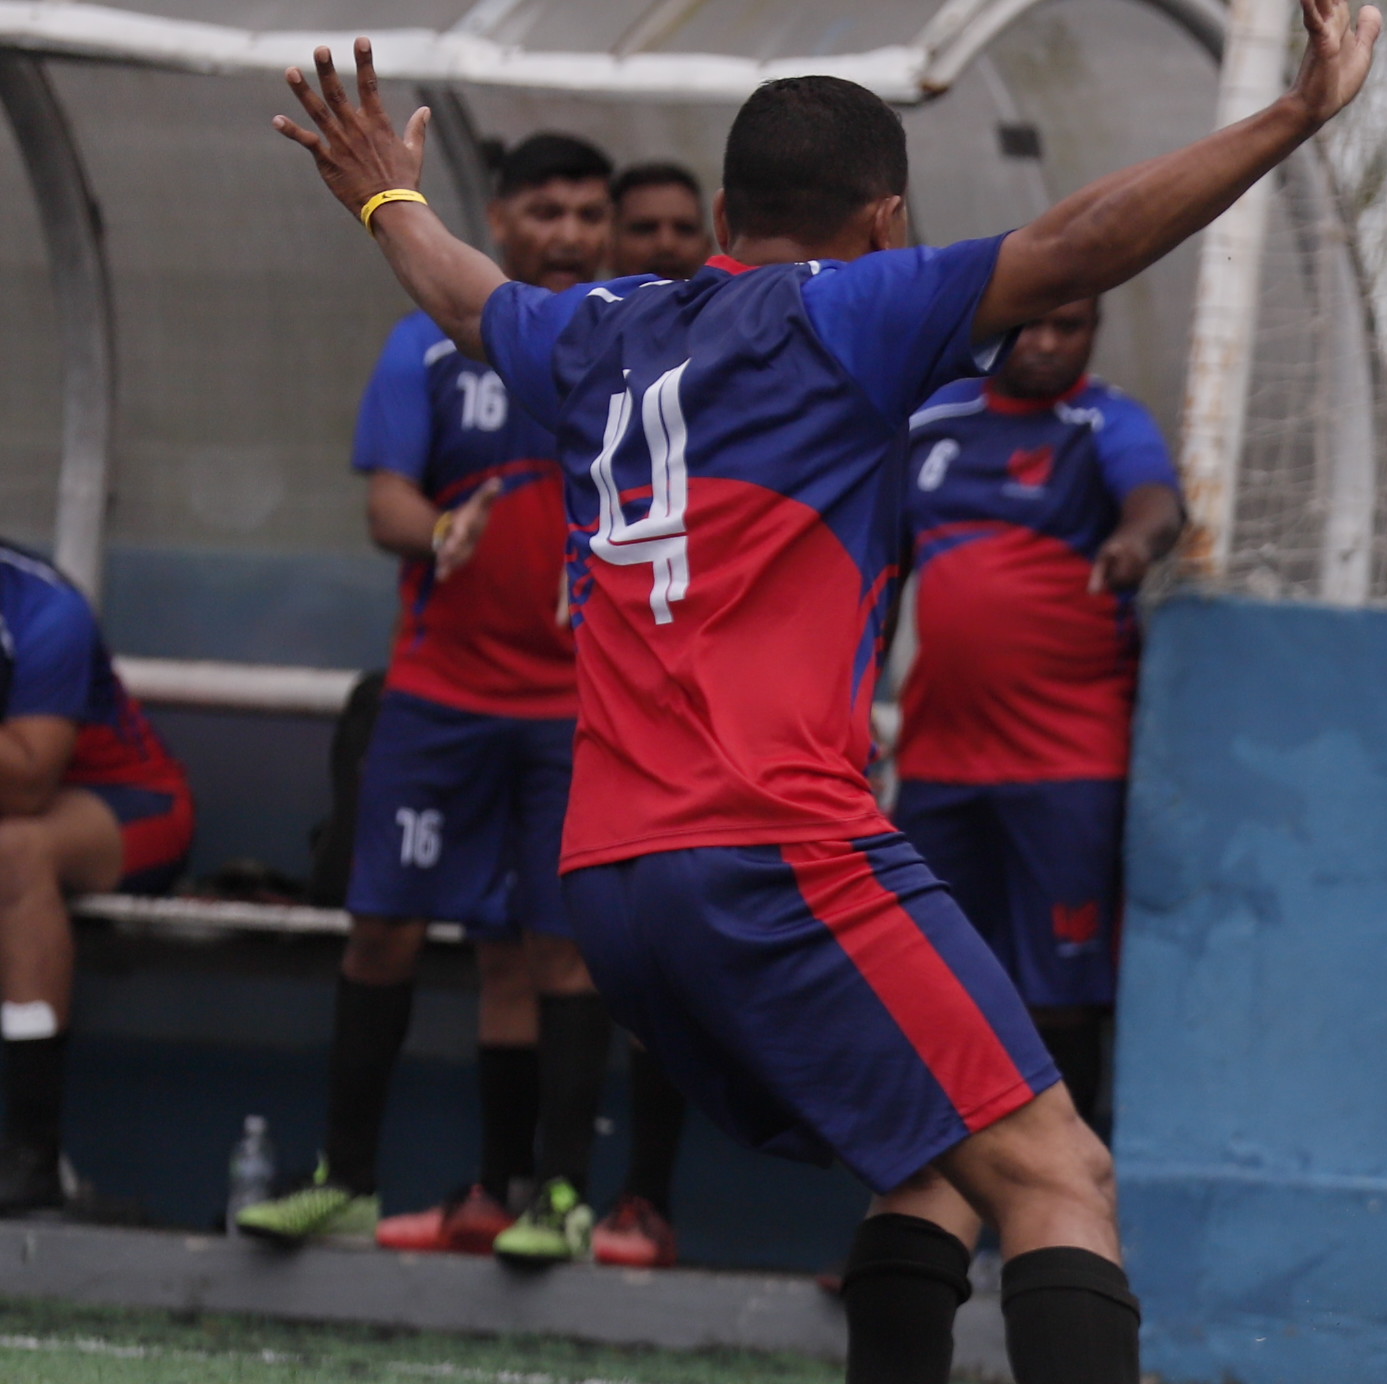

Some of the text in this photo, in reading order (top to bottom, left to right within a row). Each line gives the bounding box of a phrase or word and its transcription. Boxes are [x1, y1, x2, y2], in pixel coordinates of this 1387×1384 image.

[456, 369, 509, 432] 16
[588, 357, 692, 625] 4
[396, 806, 444, 869] 16
